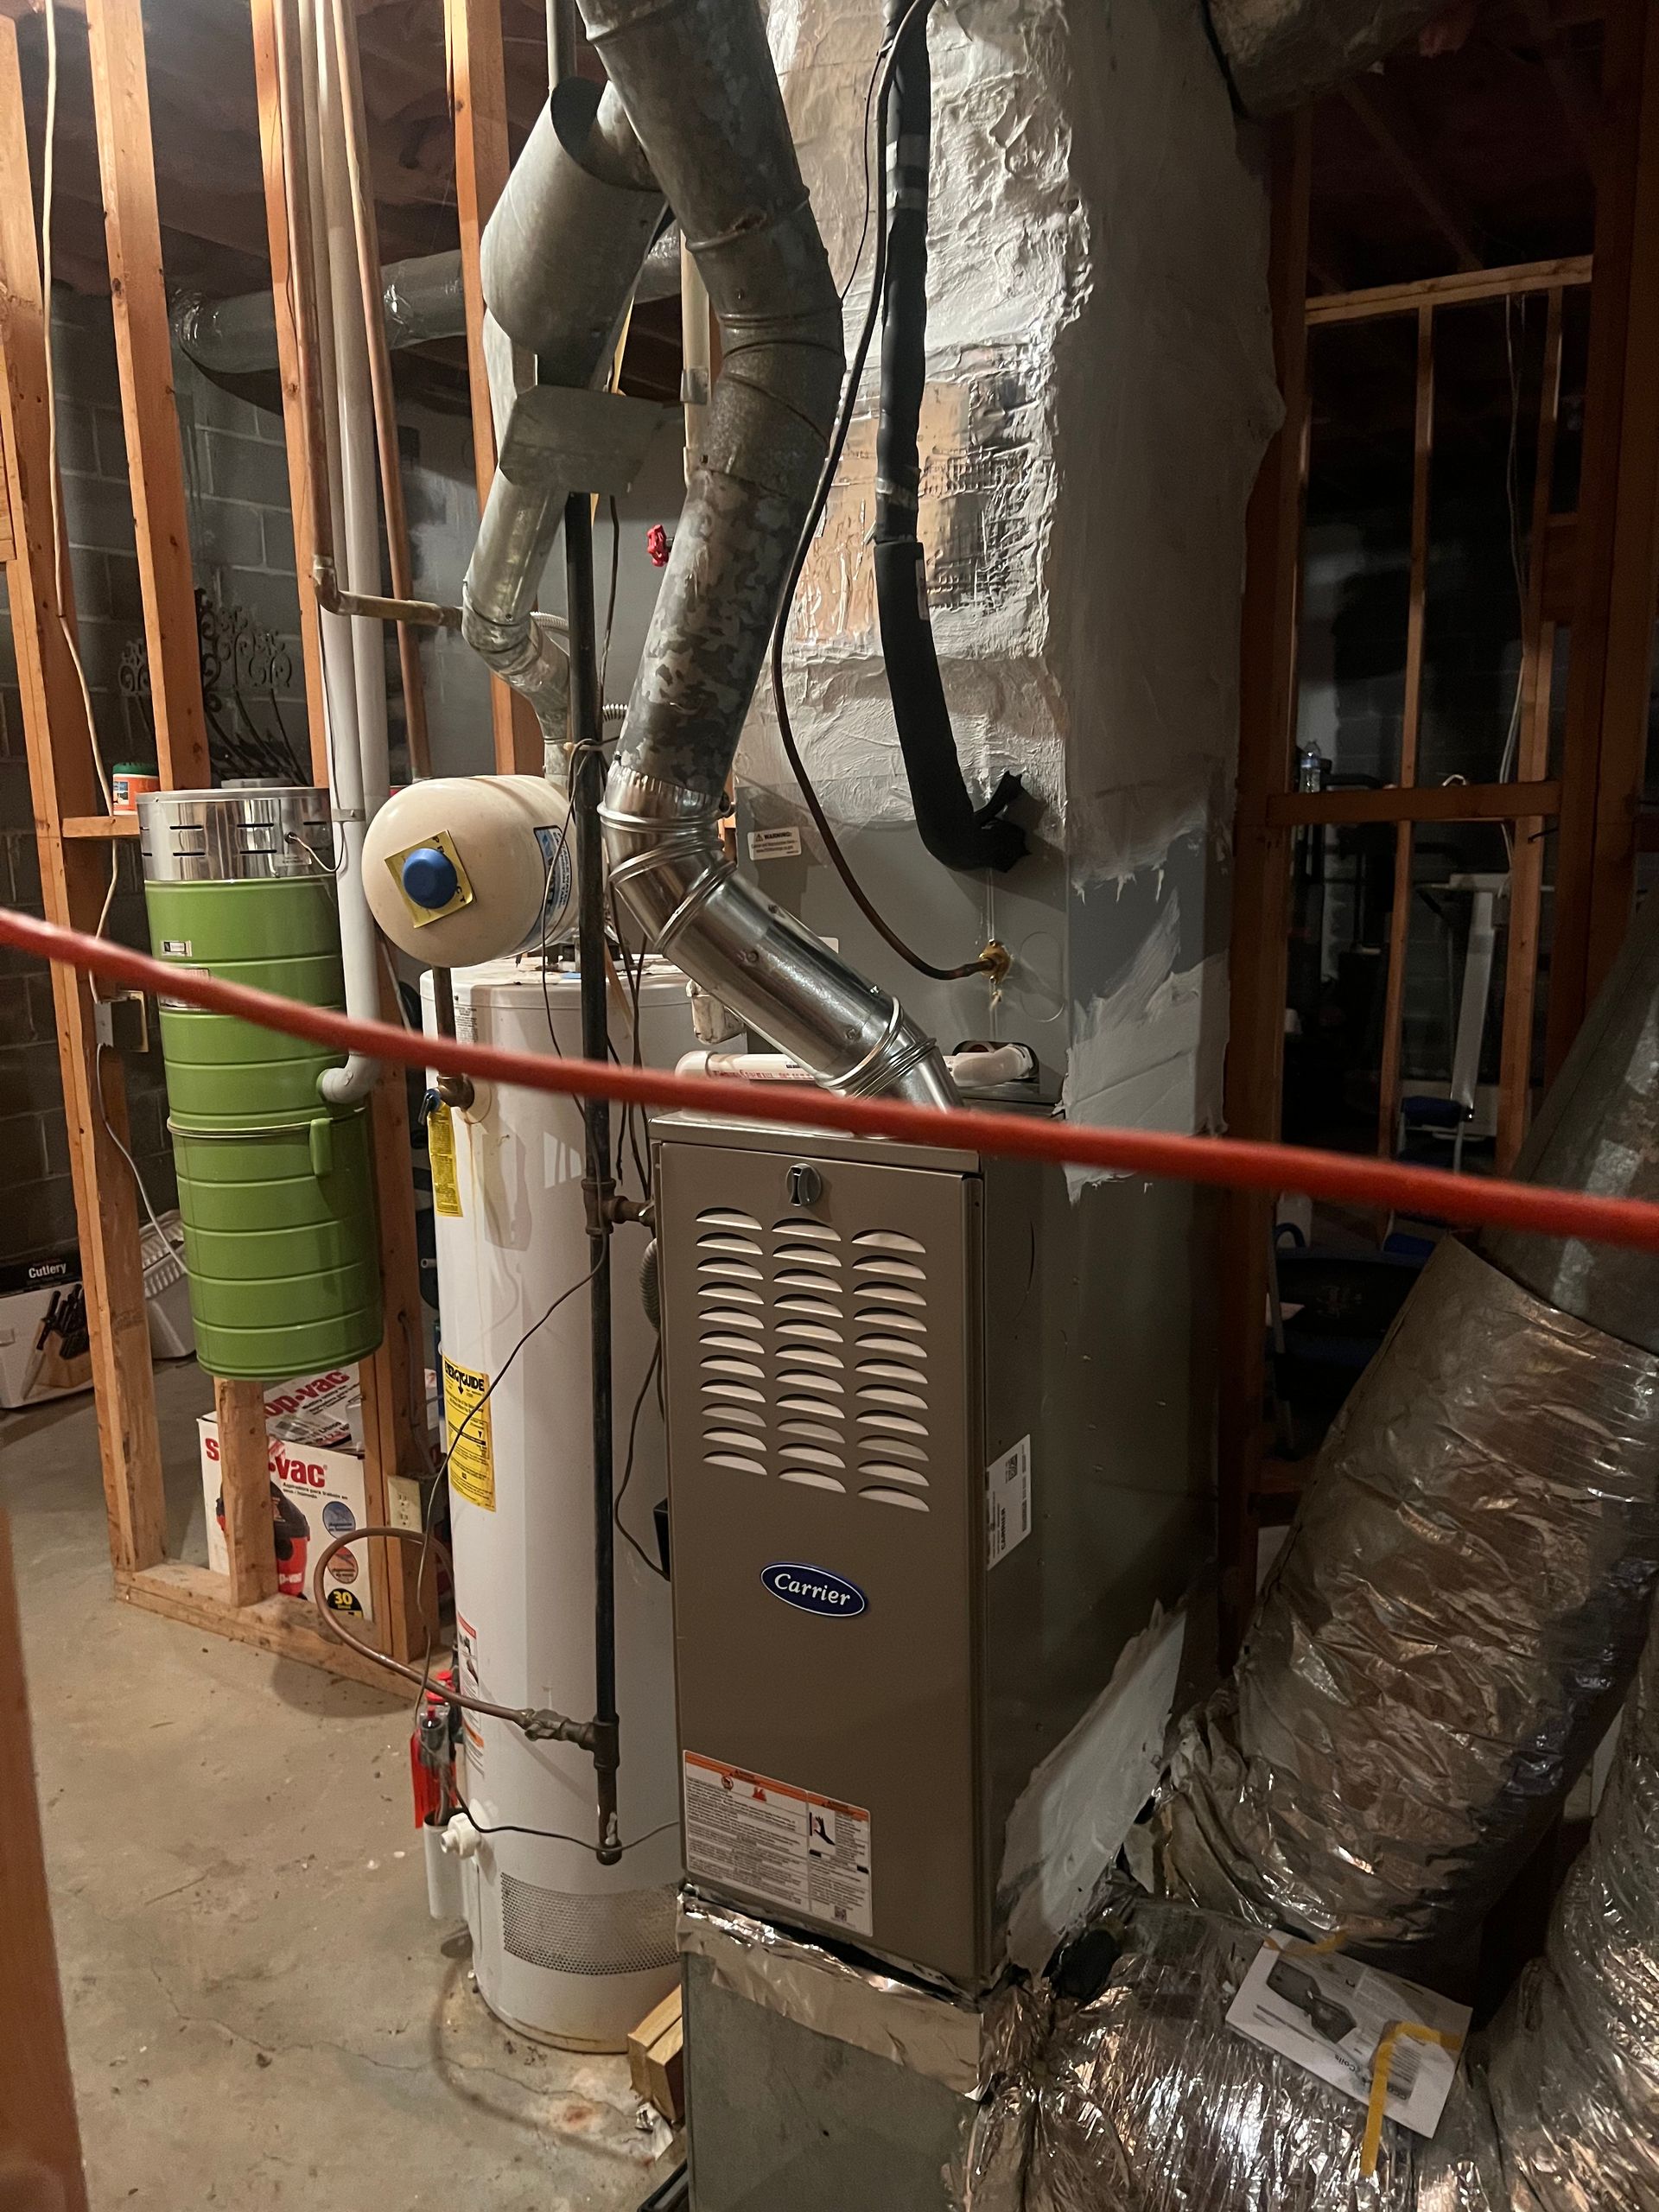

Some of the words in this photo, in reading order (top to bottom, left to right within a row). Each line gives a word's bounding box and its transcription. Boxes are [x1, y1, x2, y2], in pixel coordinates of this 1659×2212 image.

[29, 1263, 67, 1279] Cutlery
[774, 1573, 851, 1605] Carrier
[333, 1591, 353, 1605] 30
